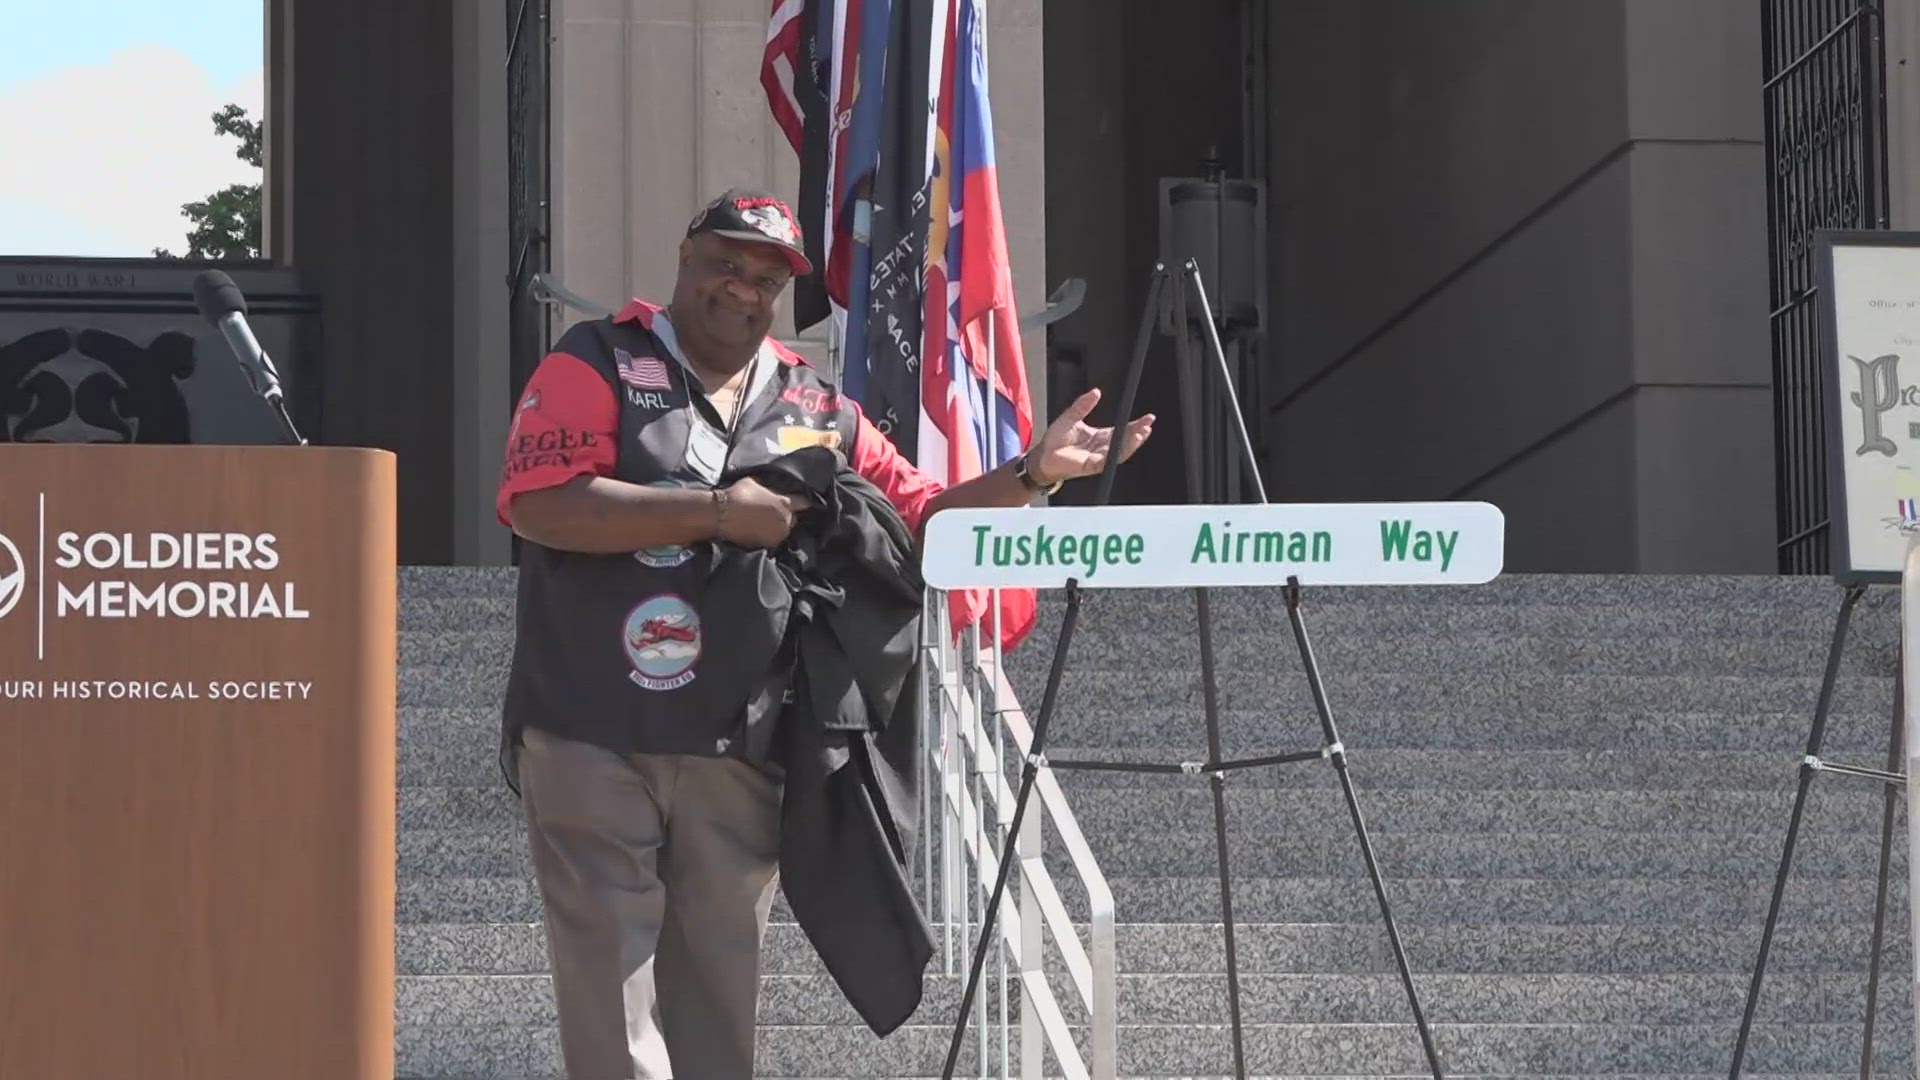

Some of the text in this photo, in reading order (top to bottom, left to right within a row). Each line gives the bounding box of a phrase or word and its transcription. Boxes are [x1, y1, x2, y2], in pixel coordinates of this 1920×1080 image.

[627, 385, 671, 409] KARL
[517, 427, 598, 455] EGEE
[55, 531, 280, 570] SOLDIERS
[972, 519, 1460, 579] Tuskegee Airman Way
[57, 581, 310, 618] MEMORIAL
[53, 680, 200, 699] HISTORICAL
[207, 680, 313, 699] SOCIETY
